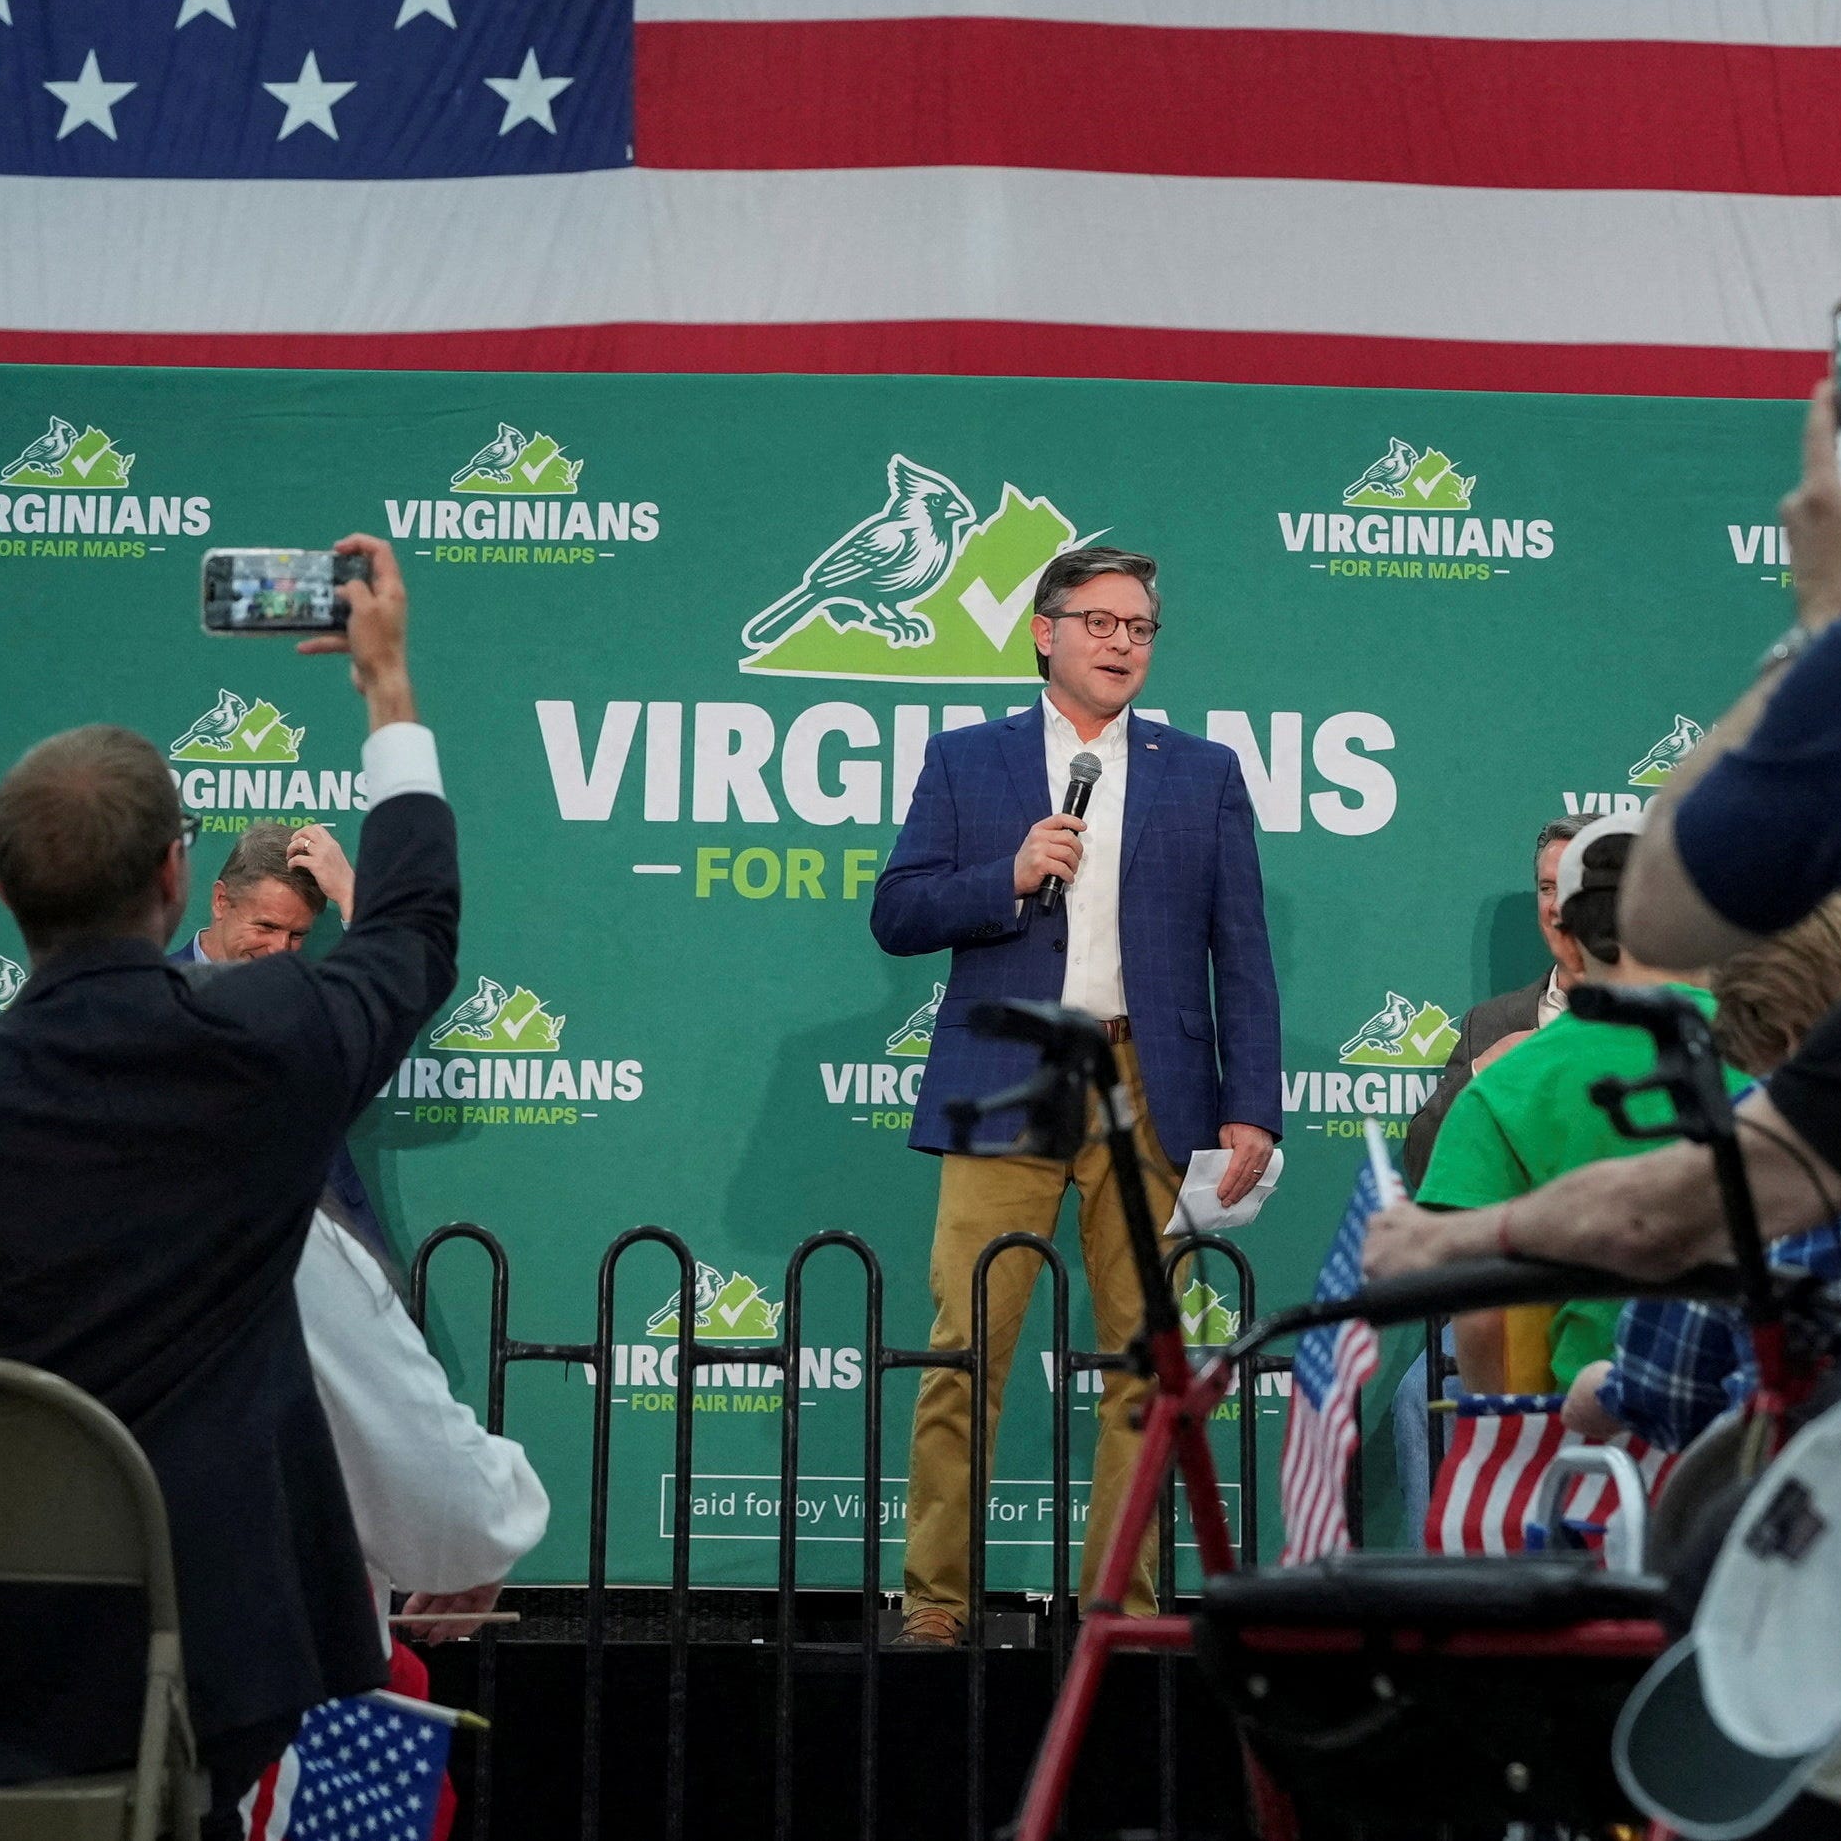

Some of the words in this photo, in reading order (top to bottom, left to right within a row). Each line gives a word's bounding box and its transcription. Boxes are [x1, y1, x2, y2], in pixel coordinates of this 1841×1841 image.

[384, 499, 660, 542] VIRGINIANS
[1277, 512, 1554, 559] VIRGINIANS
[30, 540, 79, 558] FAIR
[82, 541, 146, 559] MAPS
[434, 545, 477, 564] FOR
[481, 546, 530, 564] FAIR
[533, 546, 596, 565] MAPS
[1329, 559, 1372, 577] FOR
[1376, 560, 1424, 579] FAIR
[1428, 562, 1490, 581] MAPS
[534, 699, 1398, 837] VIRGINS
[201, 815, 246, 833] FAIR
[695, 846, 827, 900] FOR
[374, 1057, 644, 1102] IRGINIANS
[1281, 1070, 1439, 1115] VIRGIN
[414, 1105, 457, 1124] FOR
[462, 1105, 510, 1124] FAIR
[514, 1106, 578, 1125] MAPS
[871, 1111, 914, 1129] FOR
[631, 1393, 675, 1412] FOR
[690, 1394, 728, 1413] AIR
[732, 1394, 784, 1413] MAP
[690, 1492, 736, 1516] aid
[744, 1492, 781, 1517] for
[795, 1493, 827, 1524] by
[987, 1496, 1029, 1521] for
[1037, 1497, 1091, 1522] Fir
